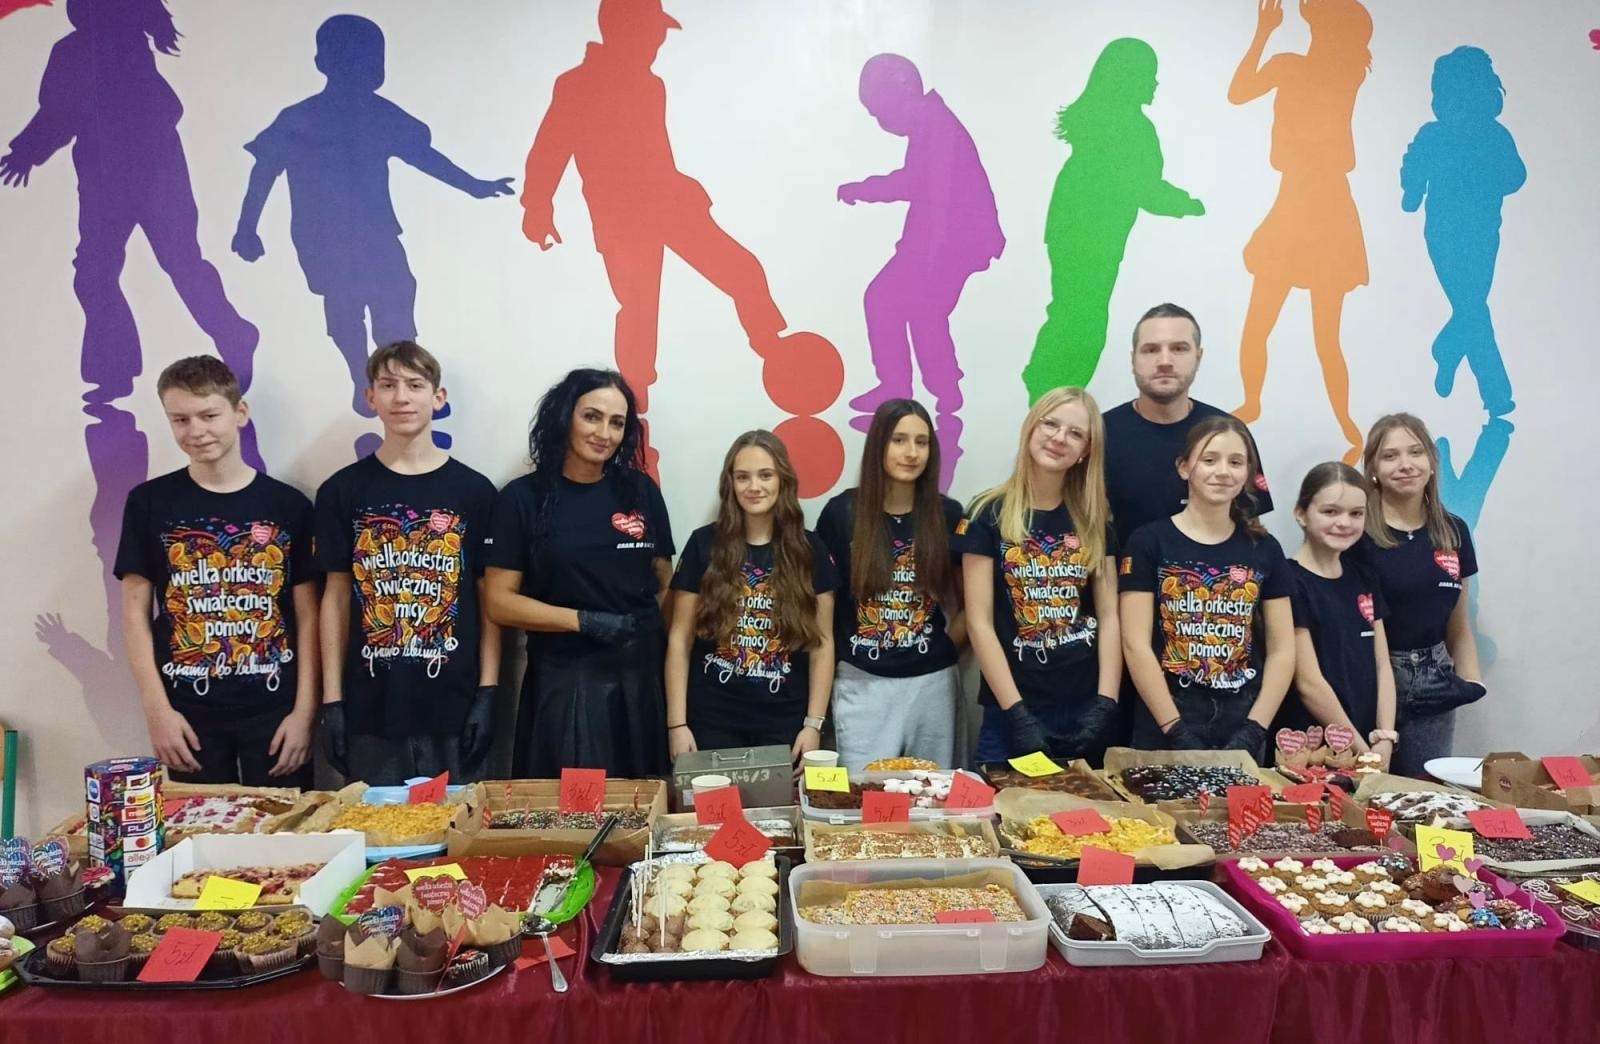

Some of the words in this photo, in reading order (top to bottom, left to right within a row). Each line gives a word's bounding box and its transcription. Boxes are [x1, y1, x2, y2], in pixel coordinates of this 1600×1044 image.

[171, 559, 219, 586] wielka
[1011, 558, 1046, 578] wielka
[1166, 591, 1203, 613] wielka
[880, 608, 915, 626] pomocy
[1038, 604, 1078, 624] pomocy
[205, 618, 259, 643] pomocy
[1188, 641, 1234, 662] pomocy
[127, 820, 153, 833] PLAY
